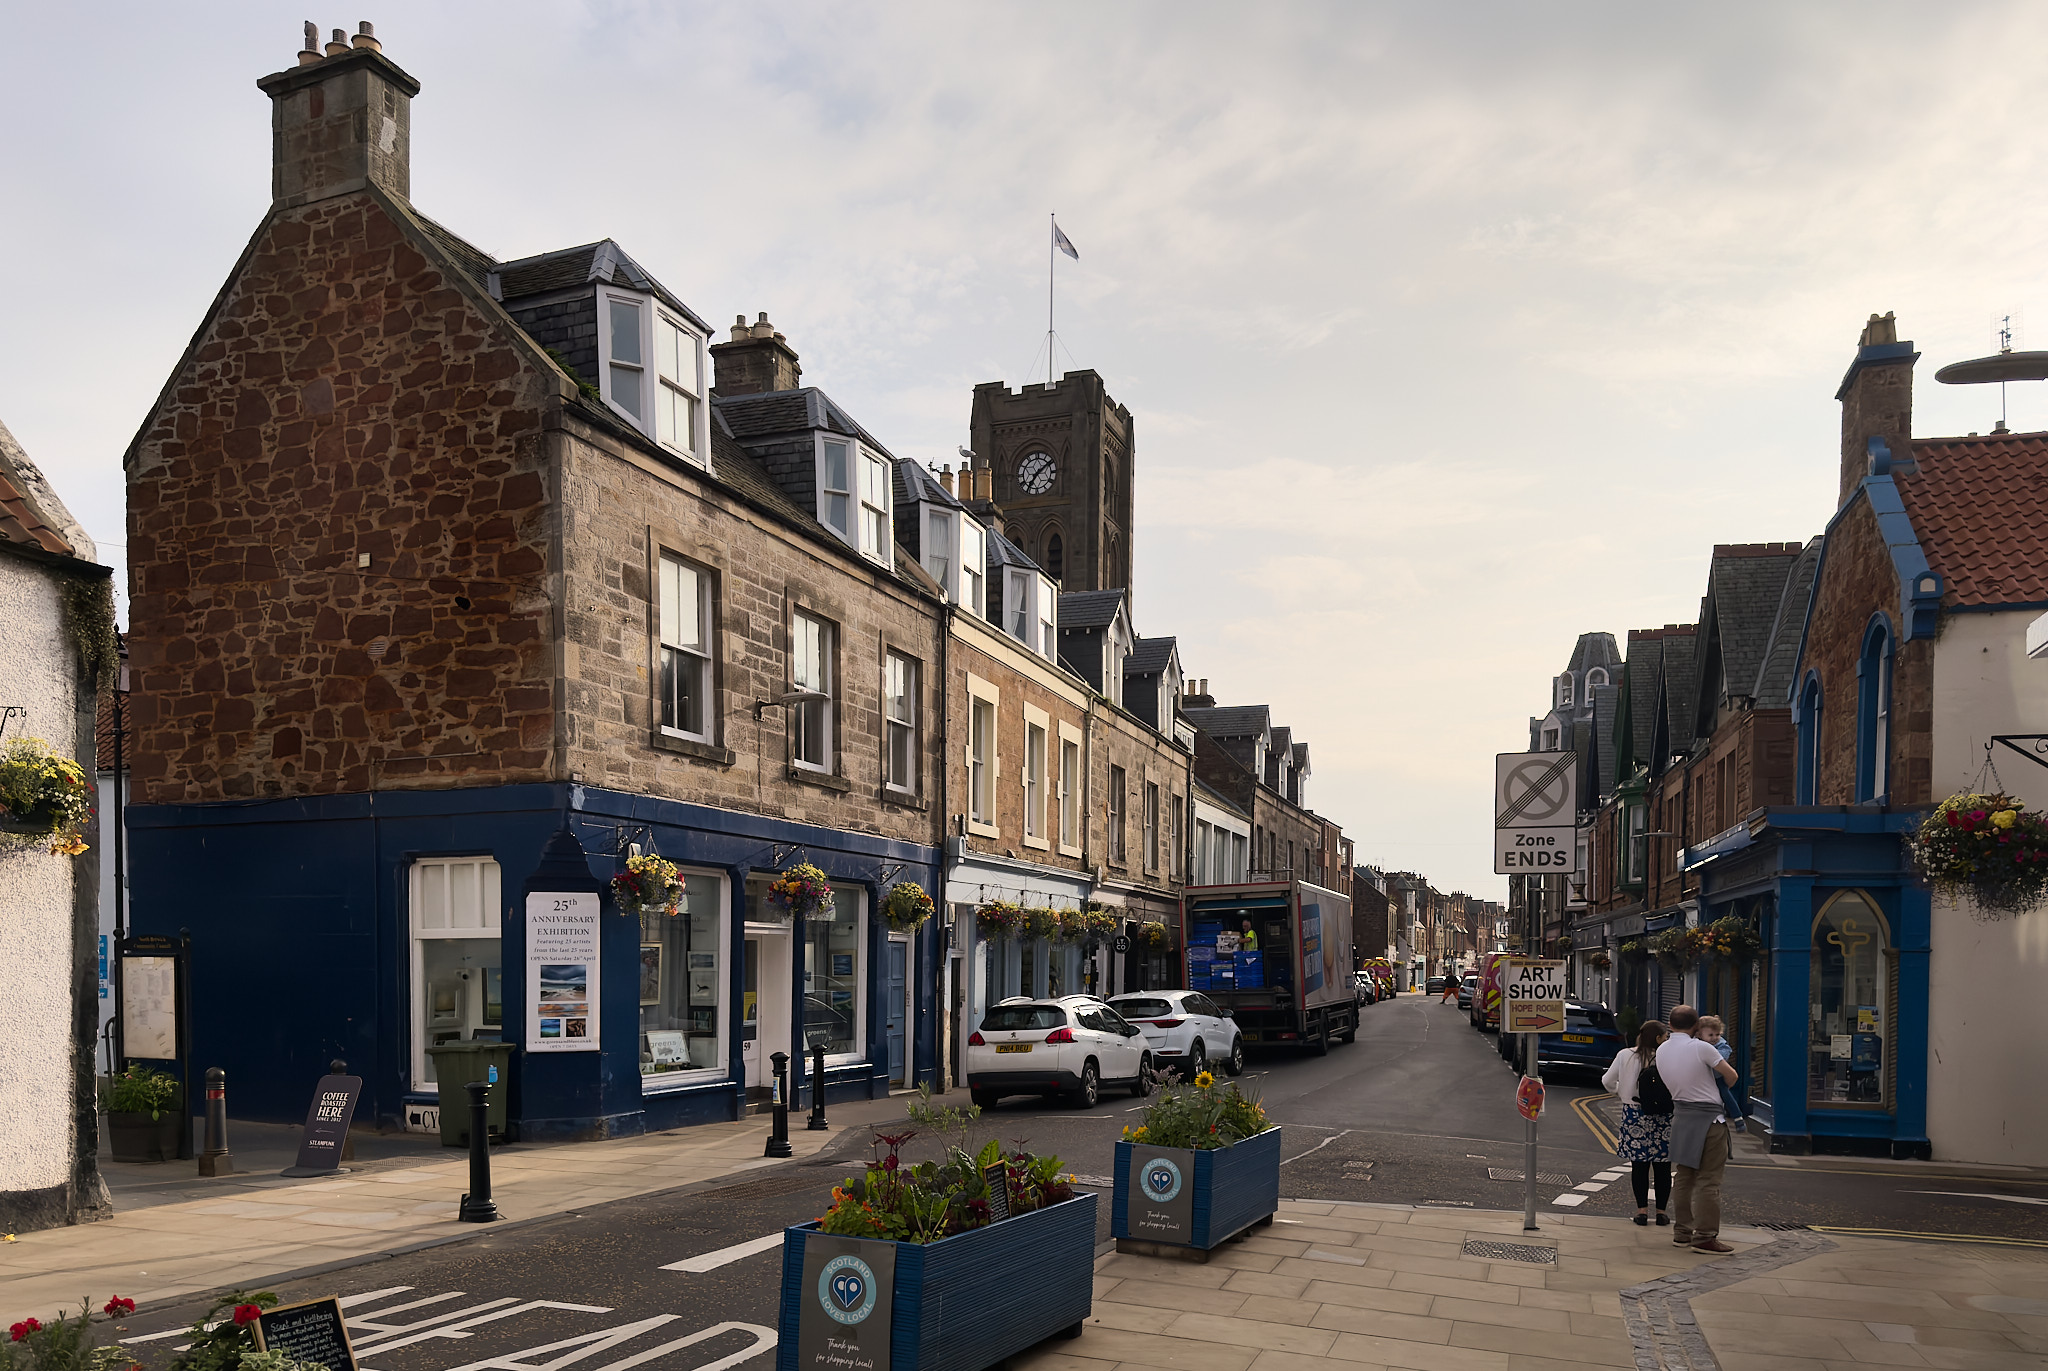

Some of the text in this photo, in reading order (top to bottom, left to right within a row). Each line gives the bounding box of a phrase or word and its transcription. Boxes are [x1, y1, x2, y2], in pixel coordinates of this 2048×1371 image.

[1515, 834, 1555, 846] Zone
[1505, 850, 1567, 867] ENDS
[553, 899, 577, 911] 25th
[1519, 967, 1554, 981] ART
[1508, 984, 1563, 999] SHOW
[1511, 1004, 1533, 1012] HOPE
[649, 1040, 677, 1048] greens
[744, 1042, 751, 1051] 59
[322, 1092, 349, 1101] COFFEE
[317, 1106, 344, 1118] HERE
[1146, 1160, 1177, 1173] SCOTLAND
[1143, 1184, 1179, 1200] LOVES LOCAL
[1147, 1211, 1160, 1219] Thank
[826, 1258, 870, 1278] SCOTLAND
[822, 1296, 873, 1322] LOVES LOCAL
[270, 1320, 290, 1332] Scent
[827, 1338, 860, 1353] Thank you
[815, 1353, 825, 1363] for
[826, 1354, 854, 1369] shopping
